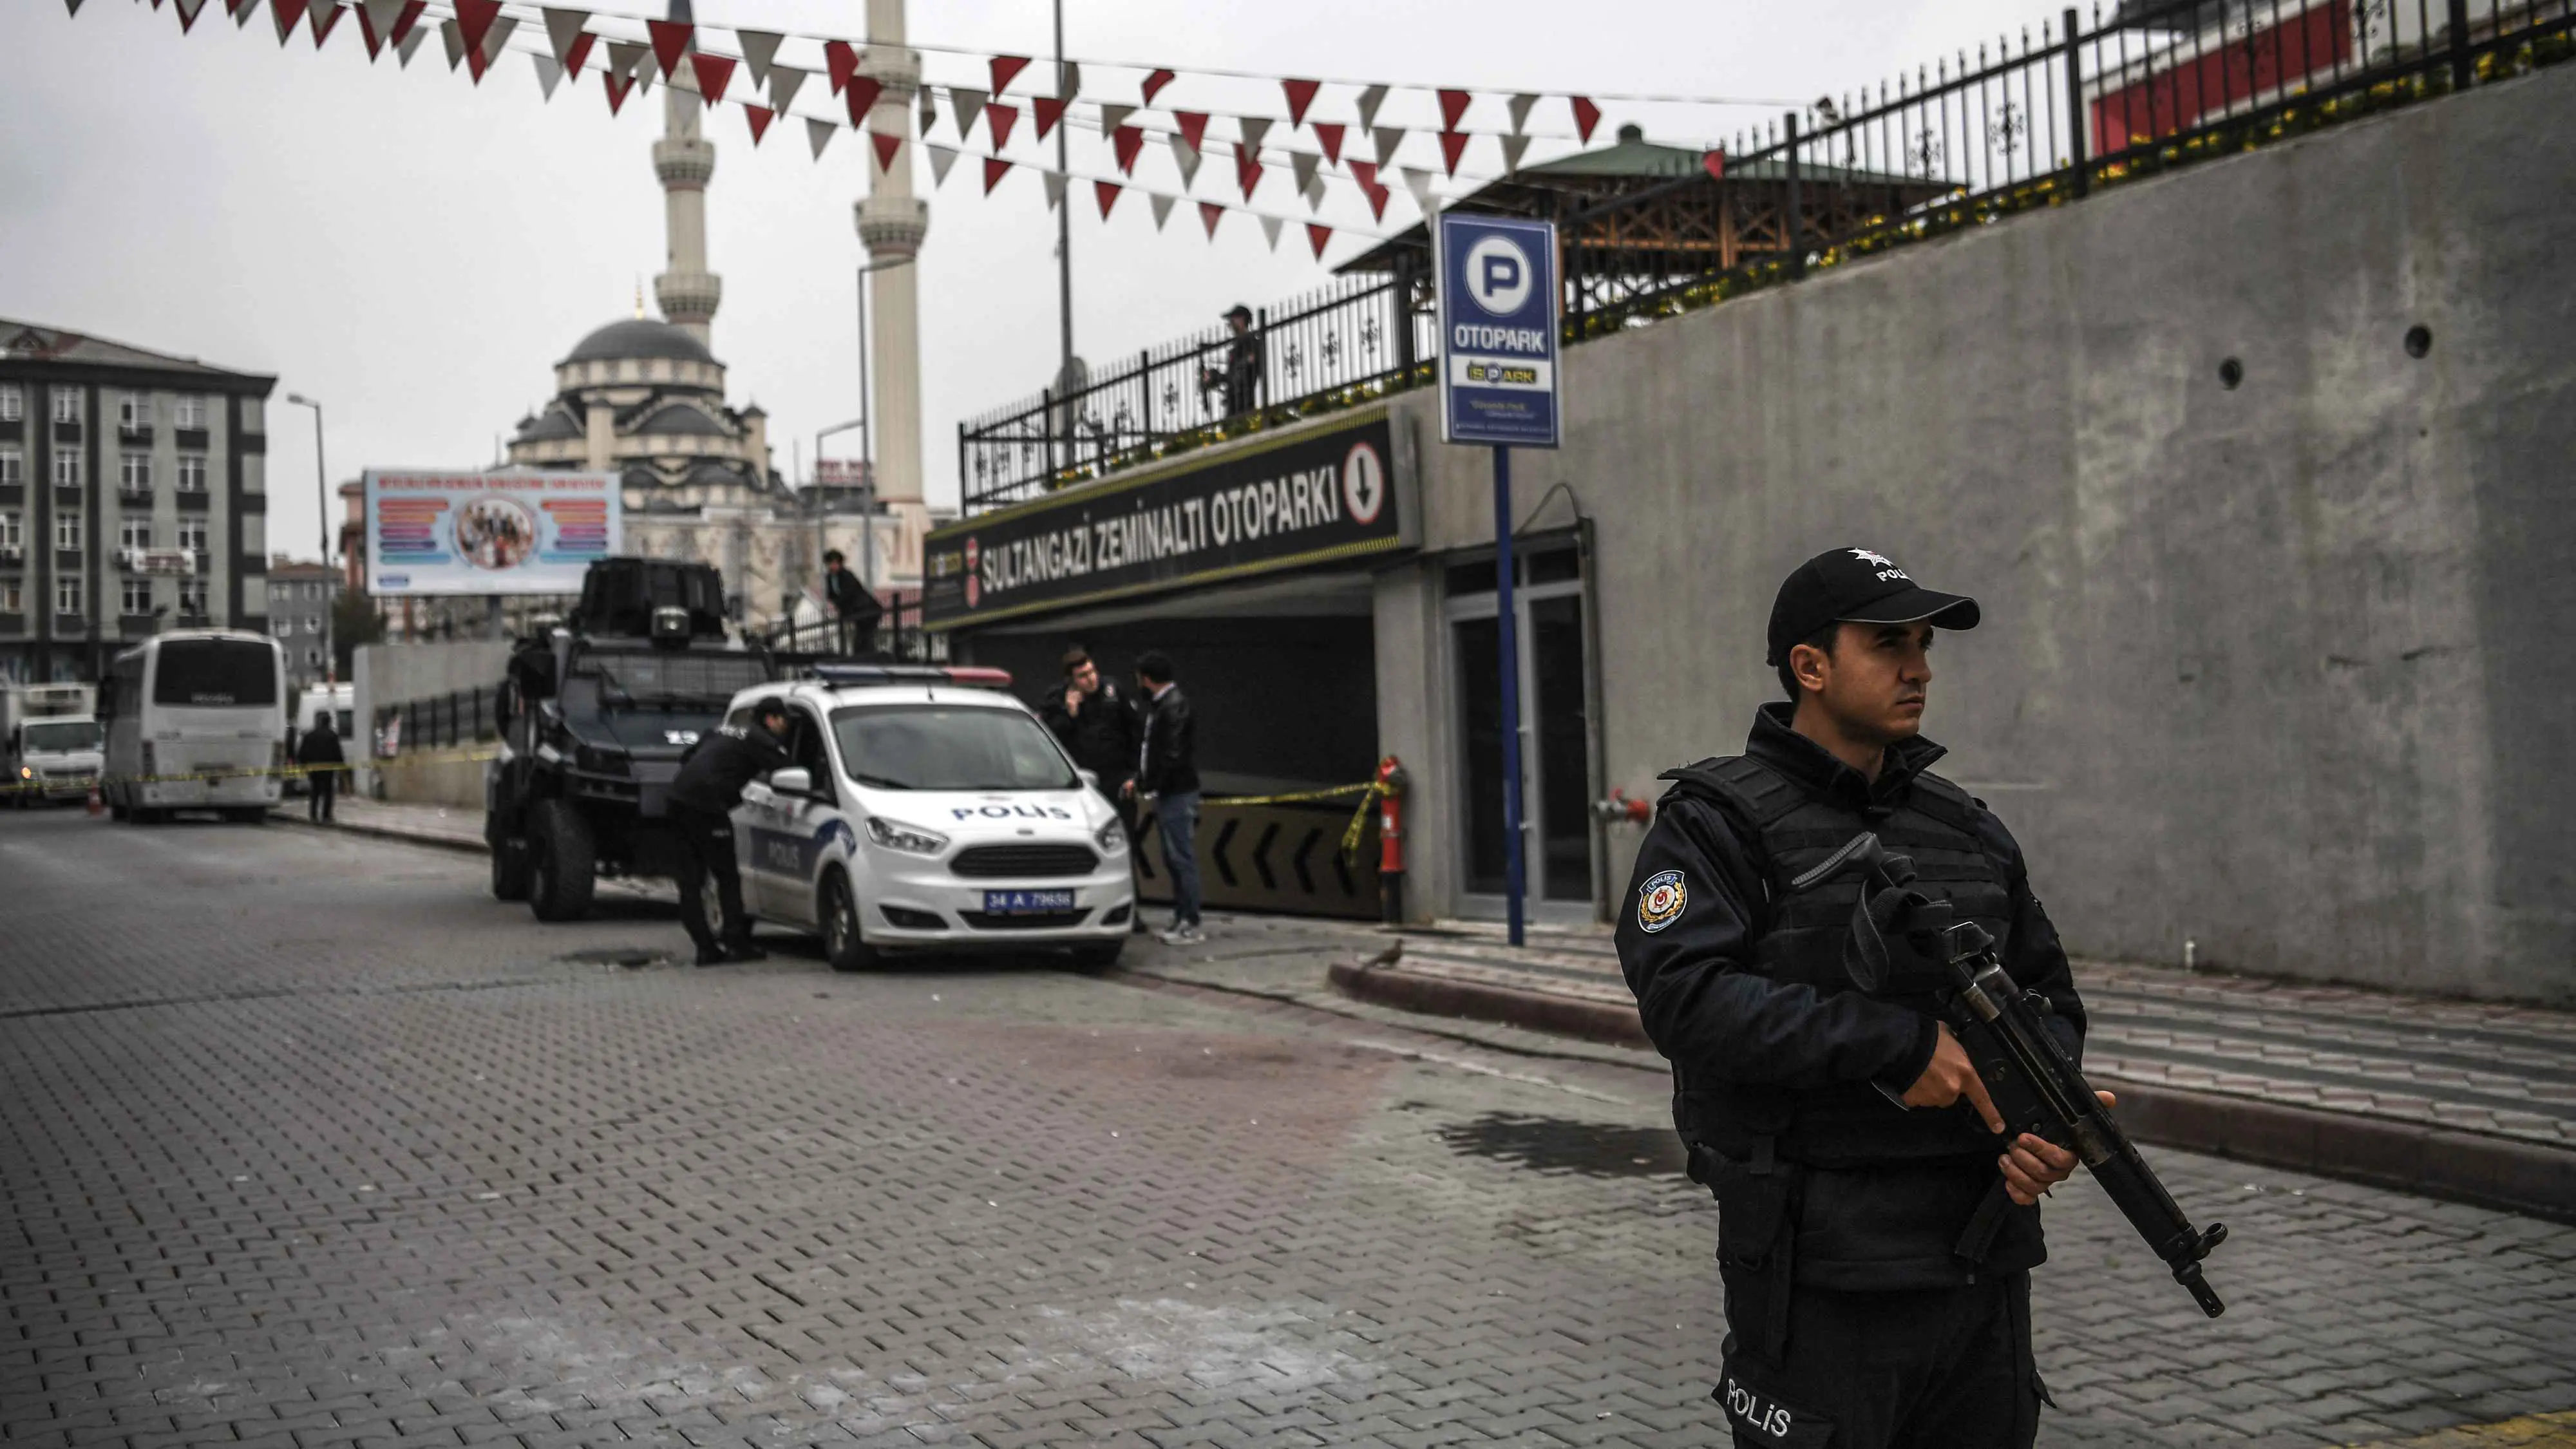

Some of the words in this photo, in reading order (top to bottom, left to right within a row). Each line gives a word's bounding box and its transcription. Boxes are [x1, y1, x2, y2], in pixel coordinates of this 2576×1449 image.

[1482, 255, 1520, 297] P
[1455, 324, 1544, 352] OTOPARK
[981, 511, 1092, 593] SULTANGAZİ
[1095, 497, 1207, 571] ZEMİNALTI
[1211, 464, 1339, 547] OTOPARKI
[989, 892, 1007, 908] 34
[1012, 891, 1026, 907] A
[1727, 1378, 1791, 1437] POLİS
